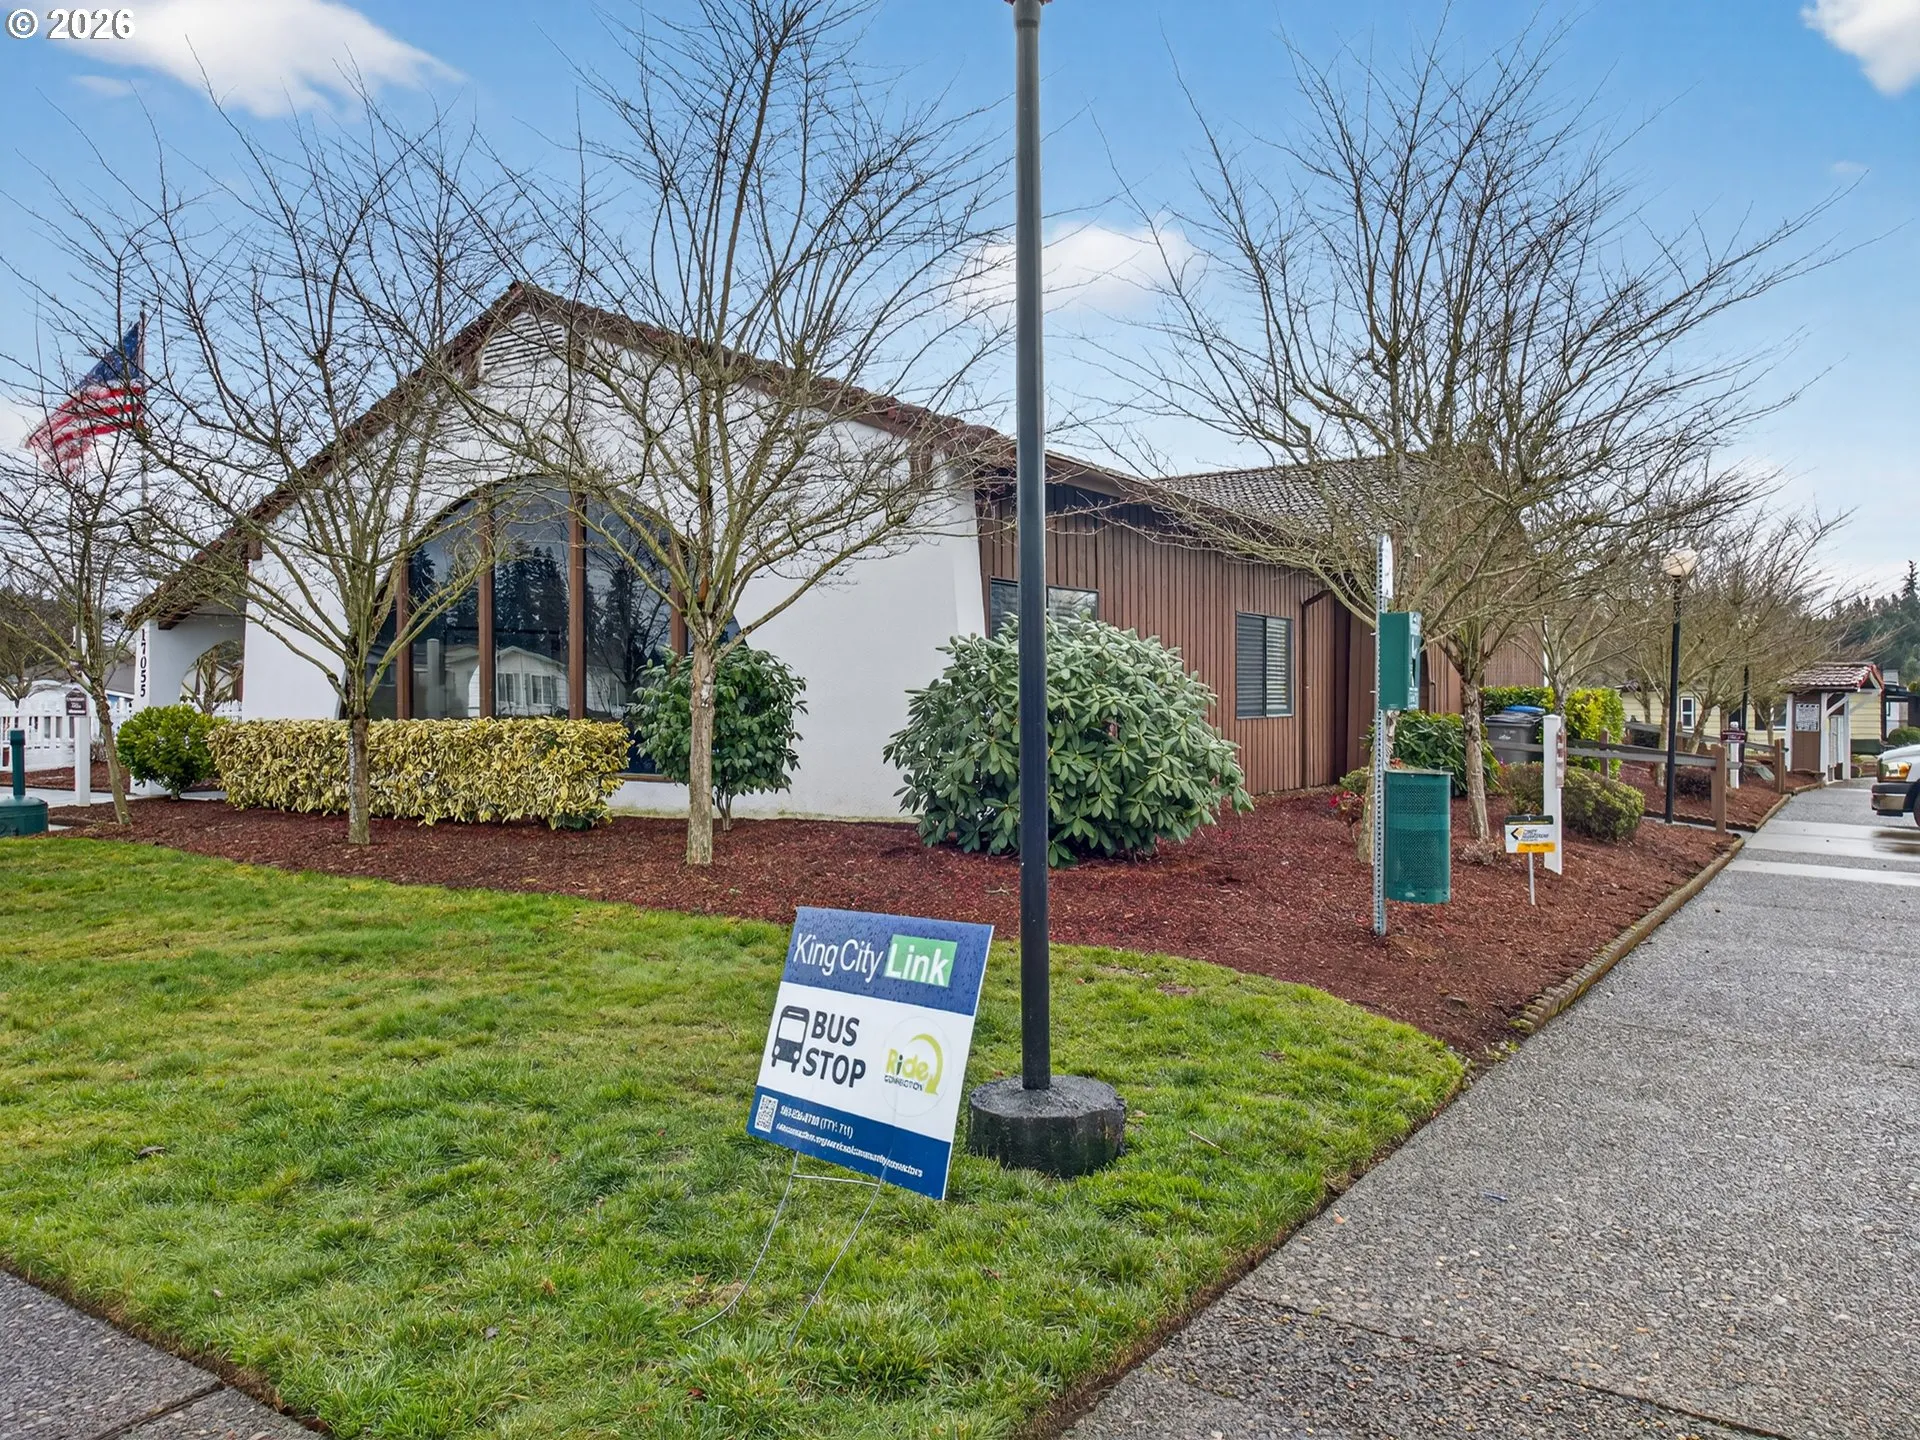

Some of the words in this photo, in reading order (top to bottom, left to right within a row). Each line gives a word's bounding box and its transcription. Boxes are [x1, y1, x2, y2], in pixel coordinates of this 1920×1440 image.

[793, 933, 839, 976] King
[840, 939, 884, 983] City
[884, 943, 949, 987] Link
[811, 1011, 860, 1047] BUS
[802, 1047, 866, 1088] STOP
[886, 1048, 929, 1081] Ride
